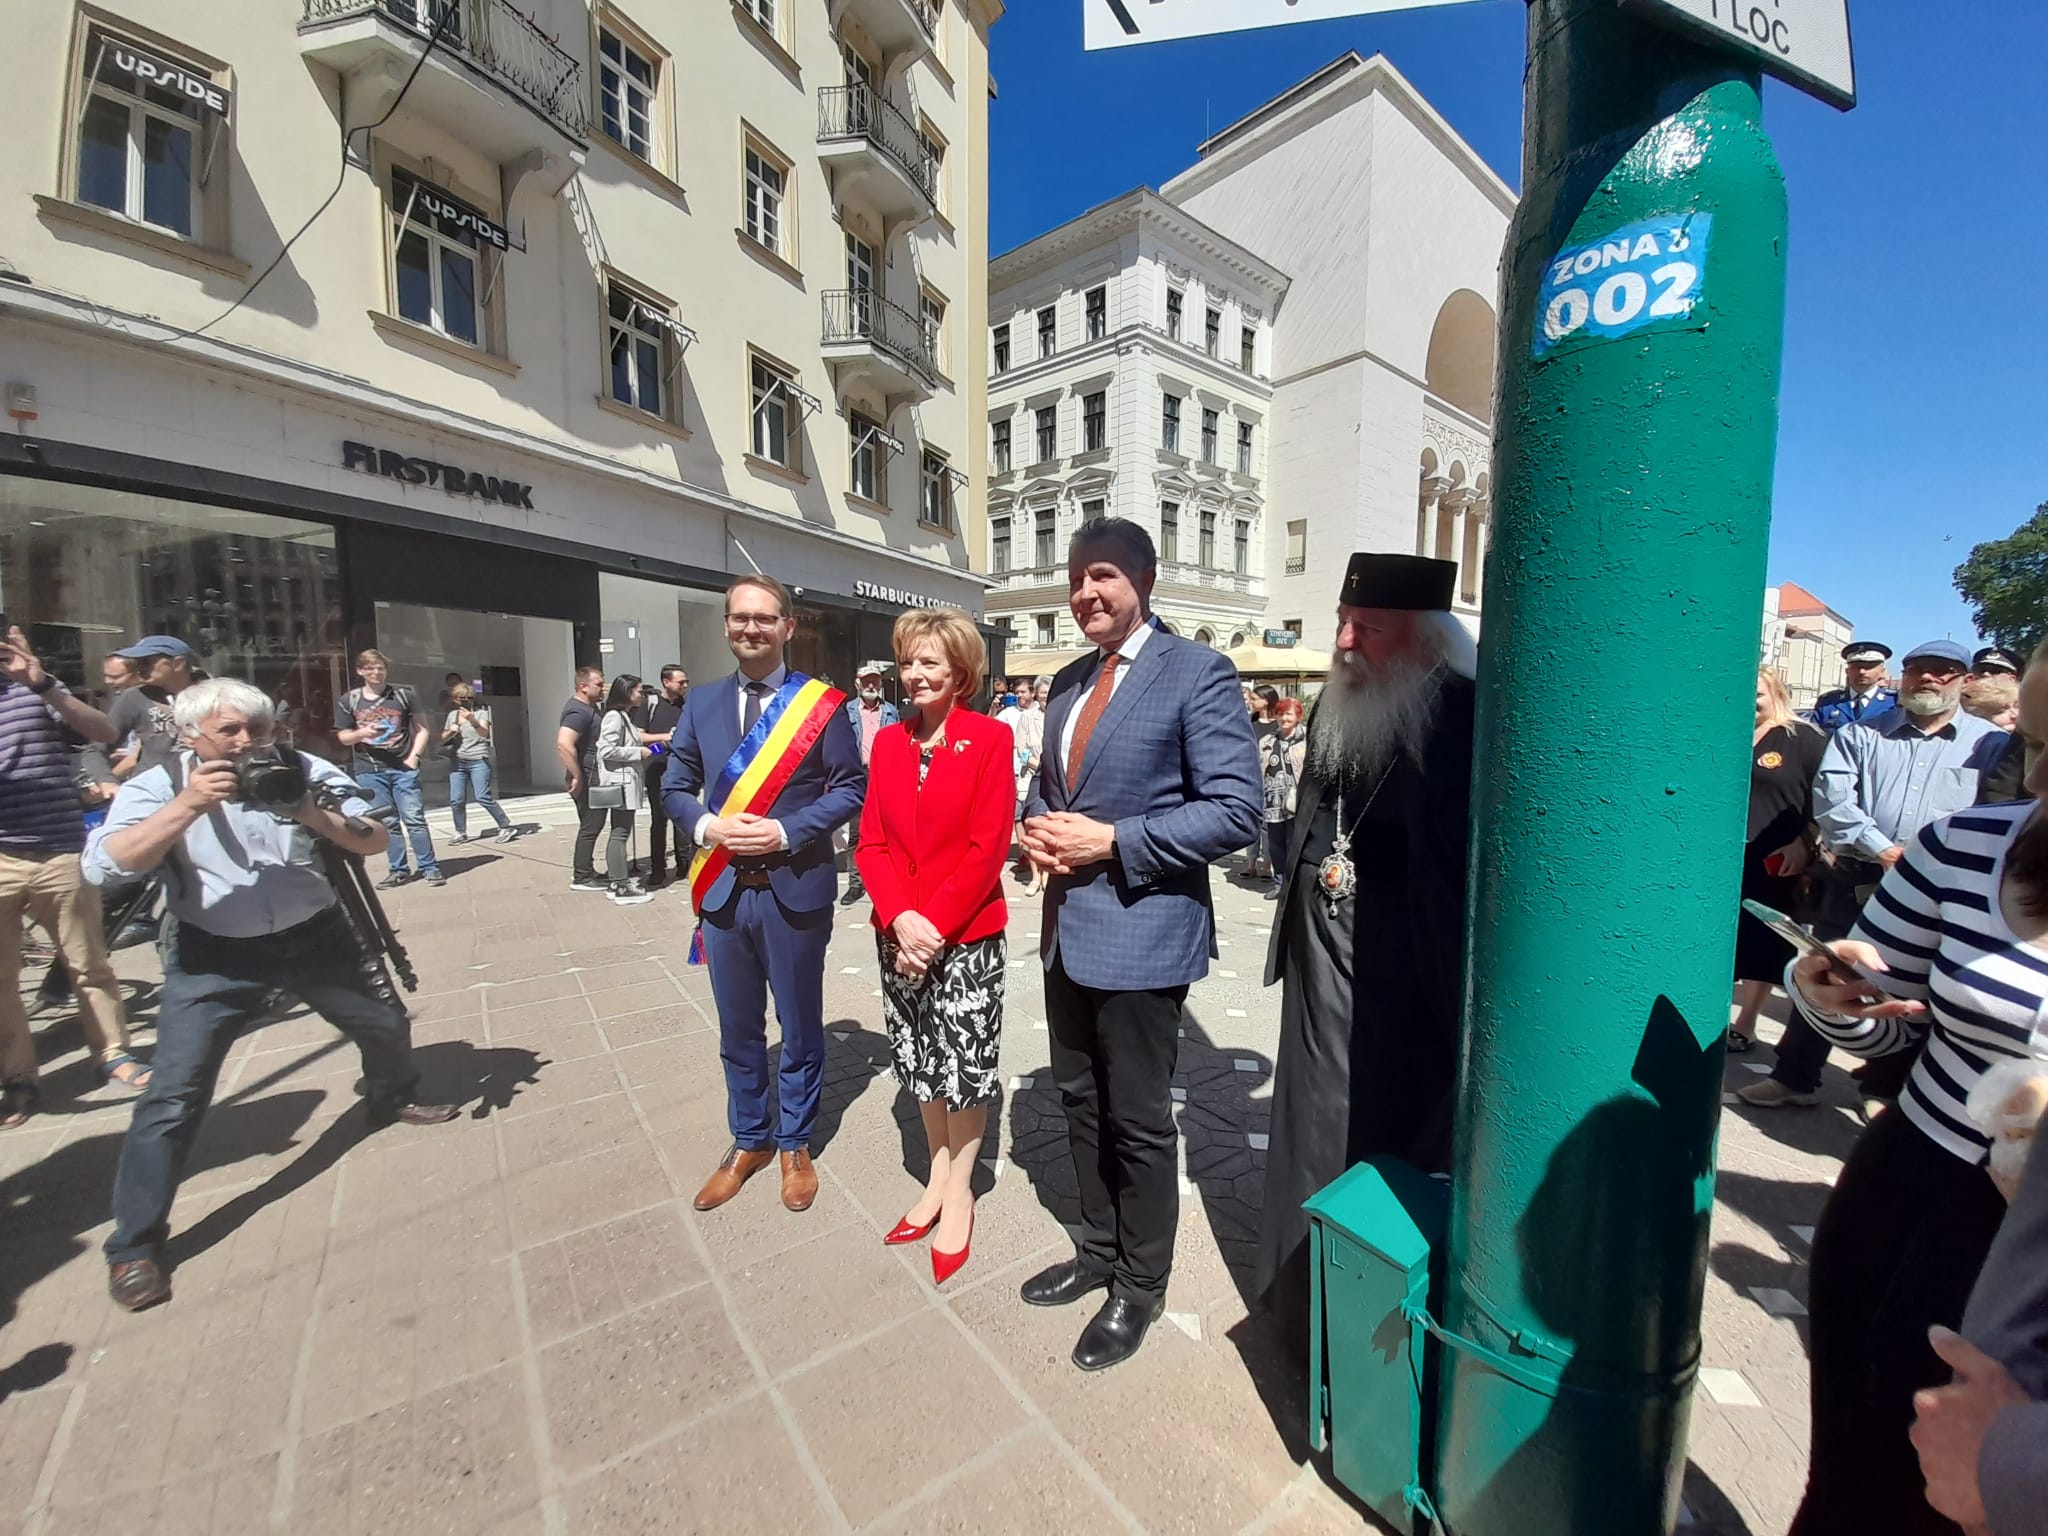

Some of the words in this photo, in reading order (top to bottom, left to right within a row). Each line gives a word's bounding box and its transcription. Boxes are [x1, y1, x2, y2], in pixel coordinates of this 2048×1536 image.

[115, 49, 224, 112] UPSIDE
[424, 193, 506, 248] UPSIDE
[1552, 232, 1661, 287] ZONA
[1543, 261, 1698, 341] 002
[855, 580, 925, 609] STARBUCKS
